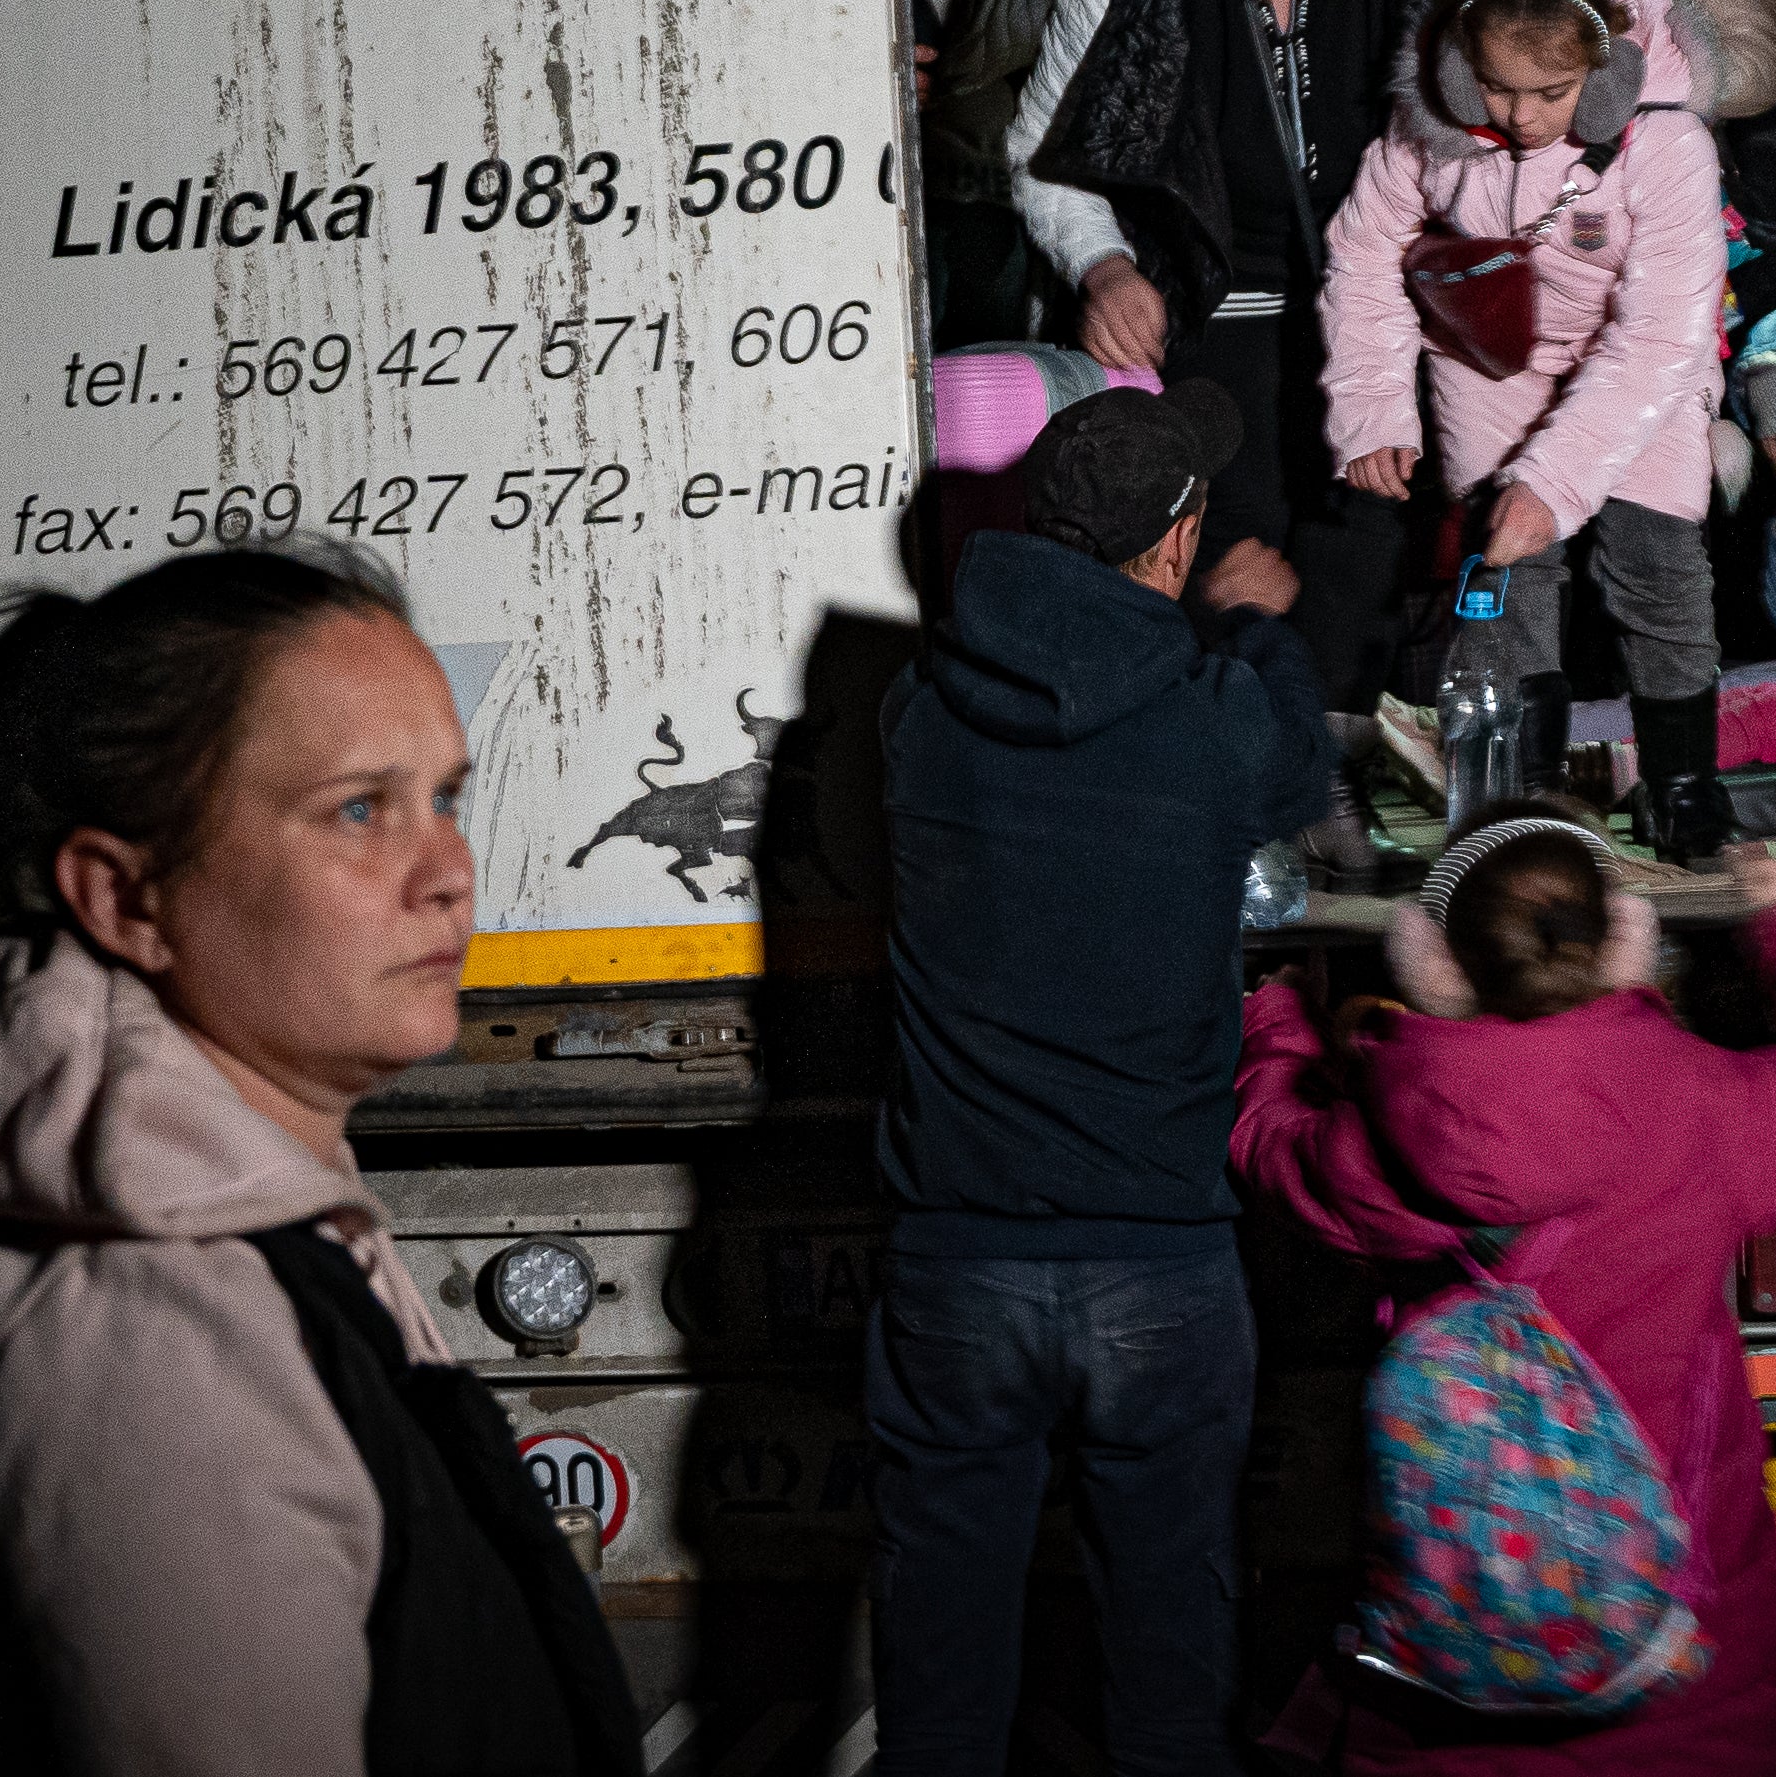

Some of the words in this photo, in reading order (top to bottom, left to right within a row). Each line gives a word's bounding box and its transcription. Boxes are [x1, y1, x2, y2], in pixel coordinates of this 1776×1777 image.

[52, 161, 374, 259] Lidická
[416, 150, 643, 236] 1983,
[680, 135, 844, 218] 580
[64, 343, 187, 411] tel.:
[218, 333, 350, 404] 569
[377, 322, 518, 388] 427
[540, 312, 695, 380] 571,
[730, 300, 872, 369] 606
[14, 495, 137, 556] fax:
[167, 484, 300, 548] 569
[328, 473, 467, 537] 427
[491, 463, 645, 534] 572,
